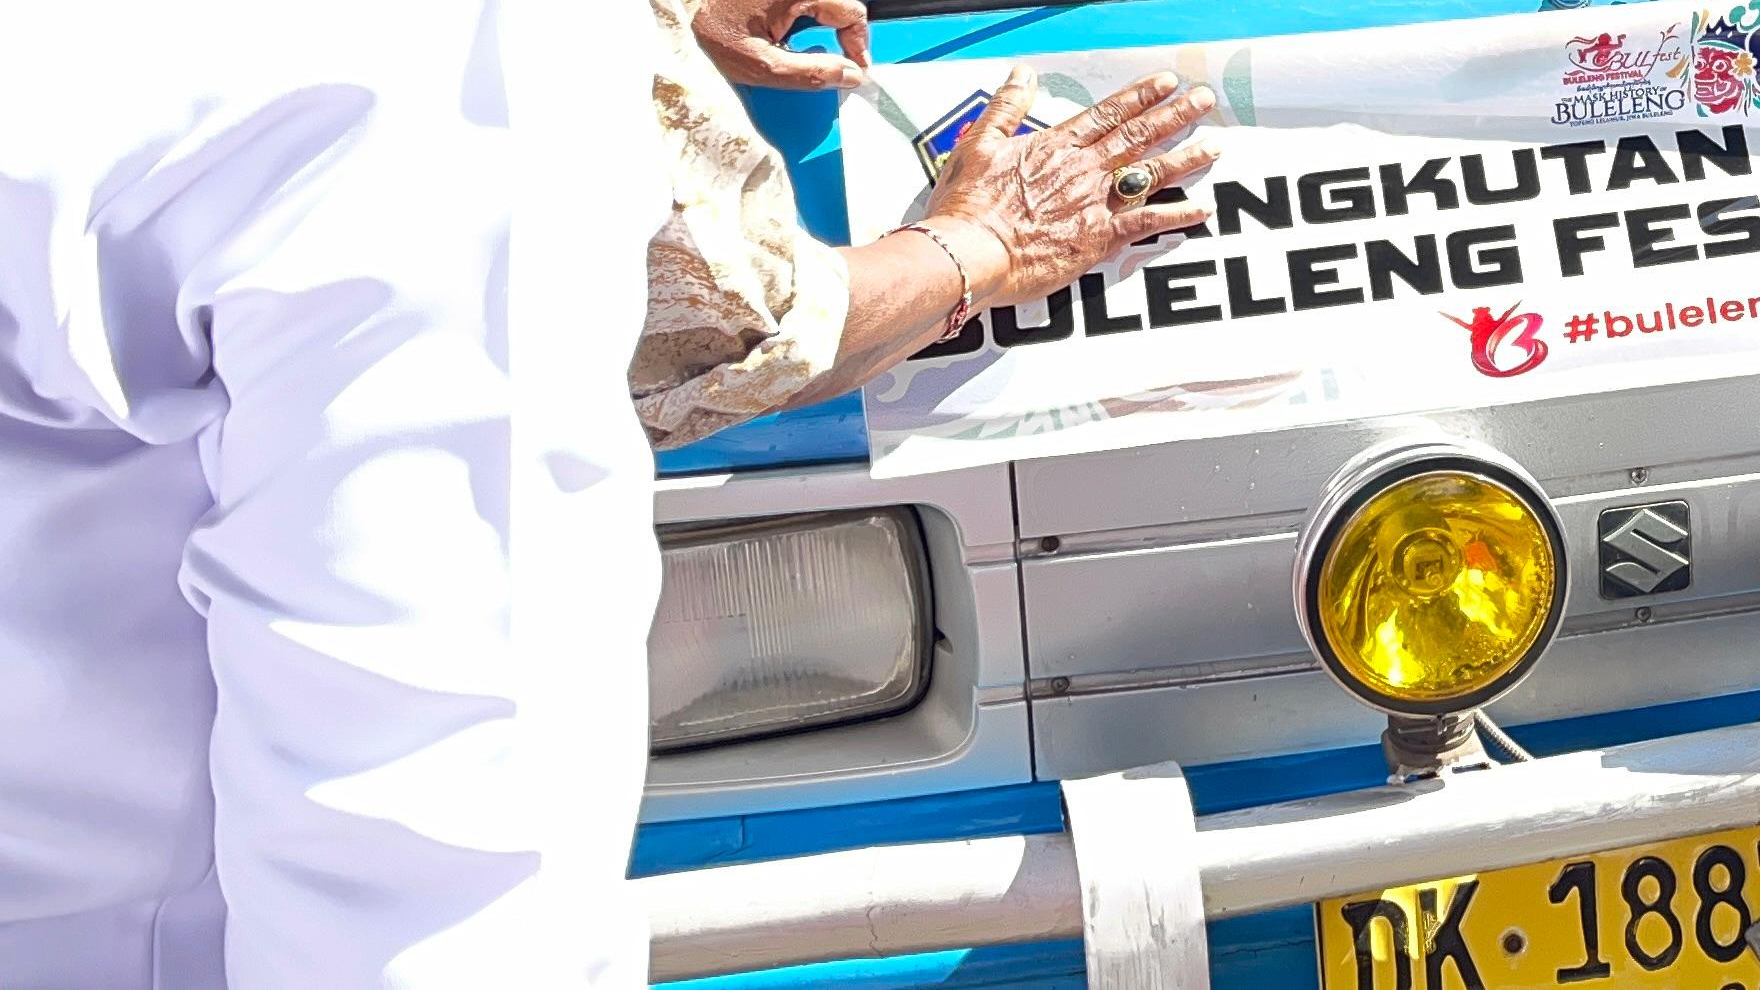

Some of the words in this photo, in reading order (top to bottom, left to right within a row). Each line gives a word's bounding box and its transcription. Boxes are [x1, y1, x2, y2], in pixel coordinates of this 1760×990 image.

[1562, 72, 1605, 86] BULELENG
[1605, 70, 1643, 81] FESTIVAL
[1574, 91, 1606, 105] MASK
[1609, 85, 1659, 103] HISTORY
[1551, 89, 1686, 125] BULELENG
